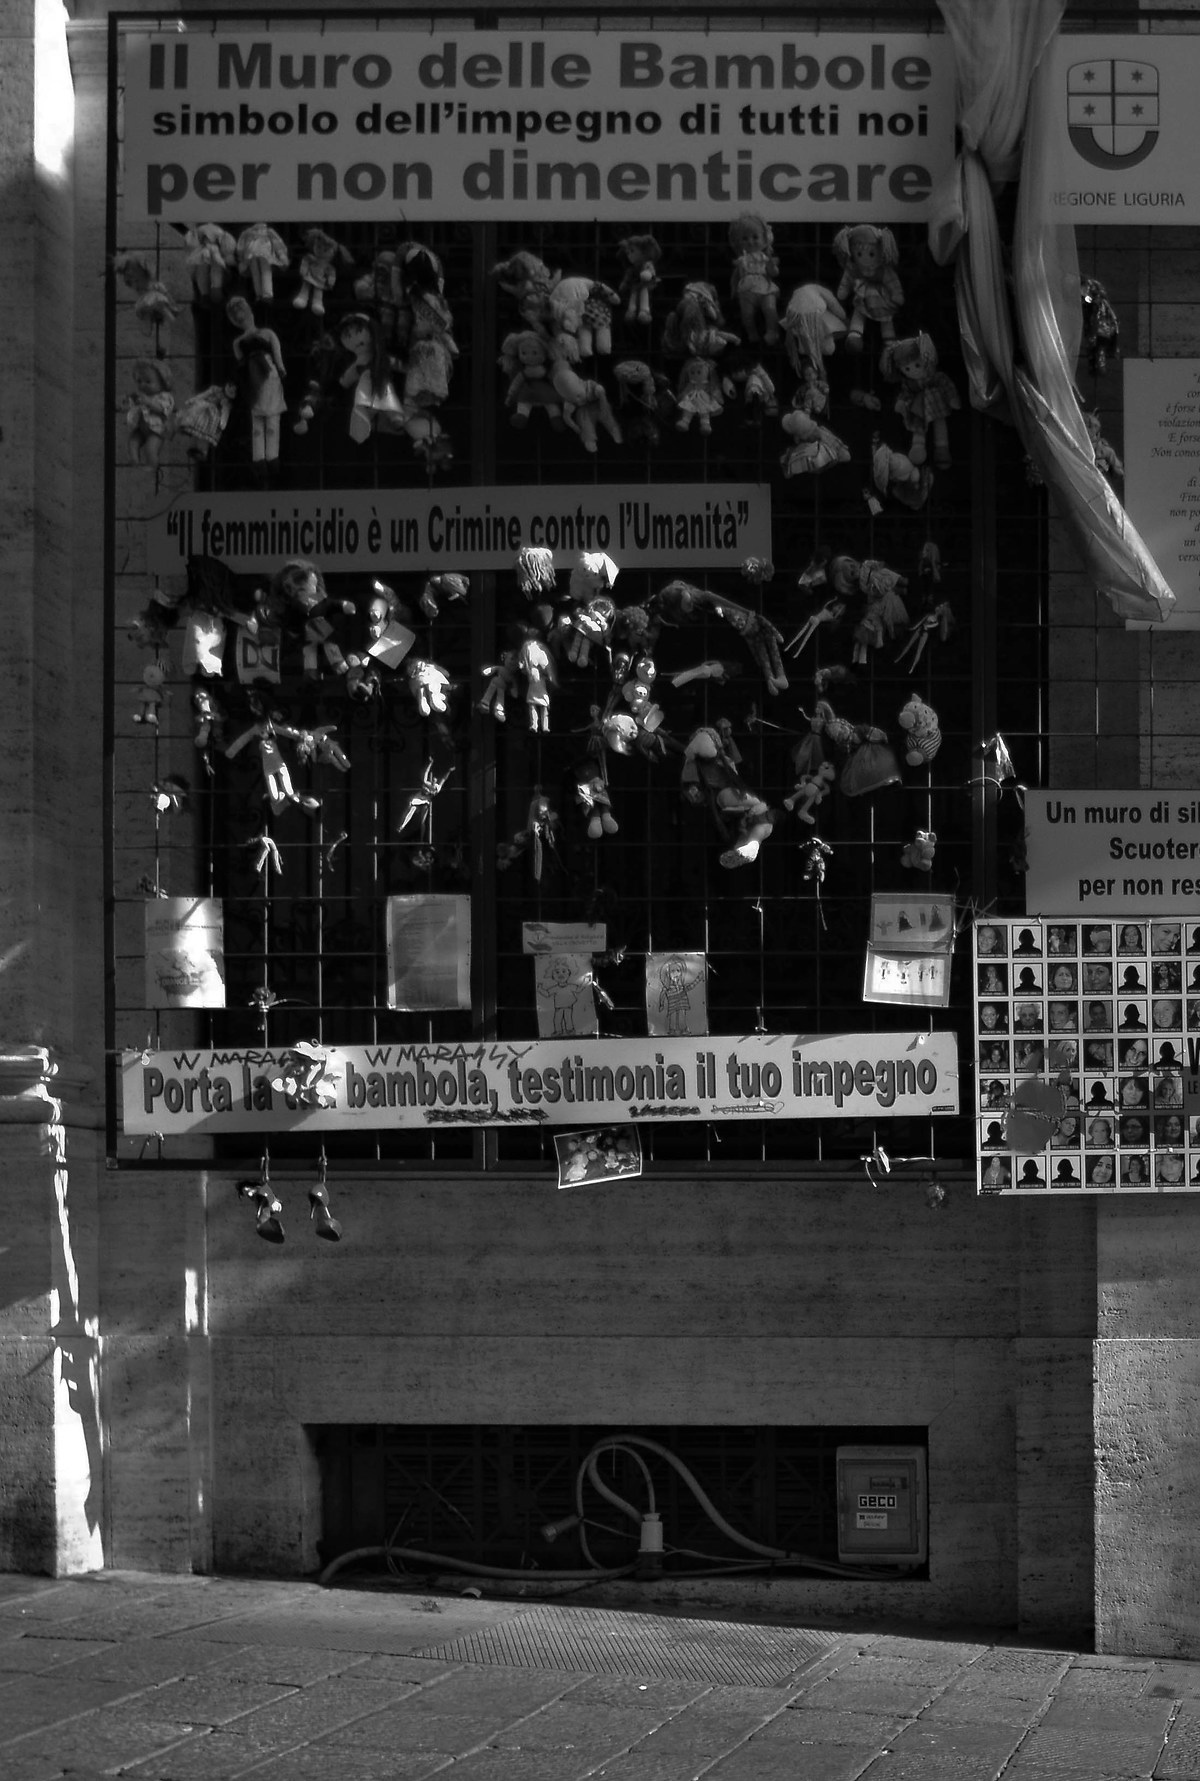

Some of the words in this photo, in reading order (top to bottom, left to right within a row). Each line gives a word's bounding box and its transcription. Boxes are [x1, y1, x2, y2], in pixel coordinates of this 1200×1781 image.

[148, 43, 190, 89] Il
[217, 43, 392, 90] Muro
[418, 42, 592, 90] delle
[620, 42, 933, 91] Bambole
[152, 103, 339, 137] simbolo
[356, 102, 662, 143] dell’impegno
[680, 103, 721, 136] di
[739, 103, 839, 137] tutti
[858, 103, 930, 137] noi
[146, 162, 271, 213] per
[297, 162, 433, 202] non
[463, 149, 934, 203] dimenticare
[1123, 192, 1186, 206] LIGURIA
[201, 507, 360, 556] femminicidio
[367, 506, 382, 554] è
[390, 518, 419, 554] un
[428, 504, 522, 553] Crimine
[529, 504, 611, 551] contro
[618, 500, 750, 550] l’Umanità”
[1170, 508, 1187, 517] non
[1183, 539, 1196, 547] un
[1046, 801, 1076, 824] Un
[1084, 807, 1142, 824] muro
[1150, 801, 1170, 824] di
[1079, 879, 1116, 901] per
[1122, 878, 1164, 896] non
[143, 1066, 233, 1114] Porta
[242, 1062, 271, 1111] la
[346, 1058, 499, 1111] bambola,
[507, 1053, 686, 1104] testimonia
[696, 1052, 716, 1100] il
[726, 1053, 783, 1099] tuo
[792, 1050, 939, 1108] impegno
